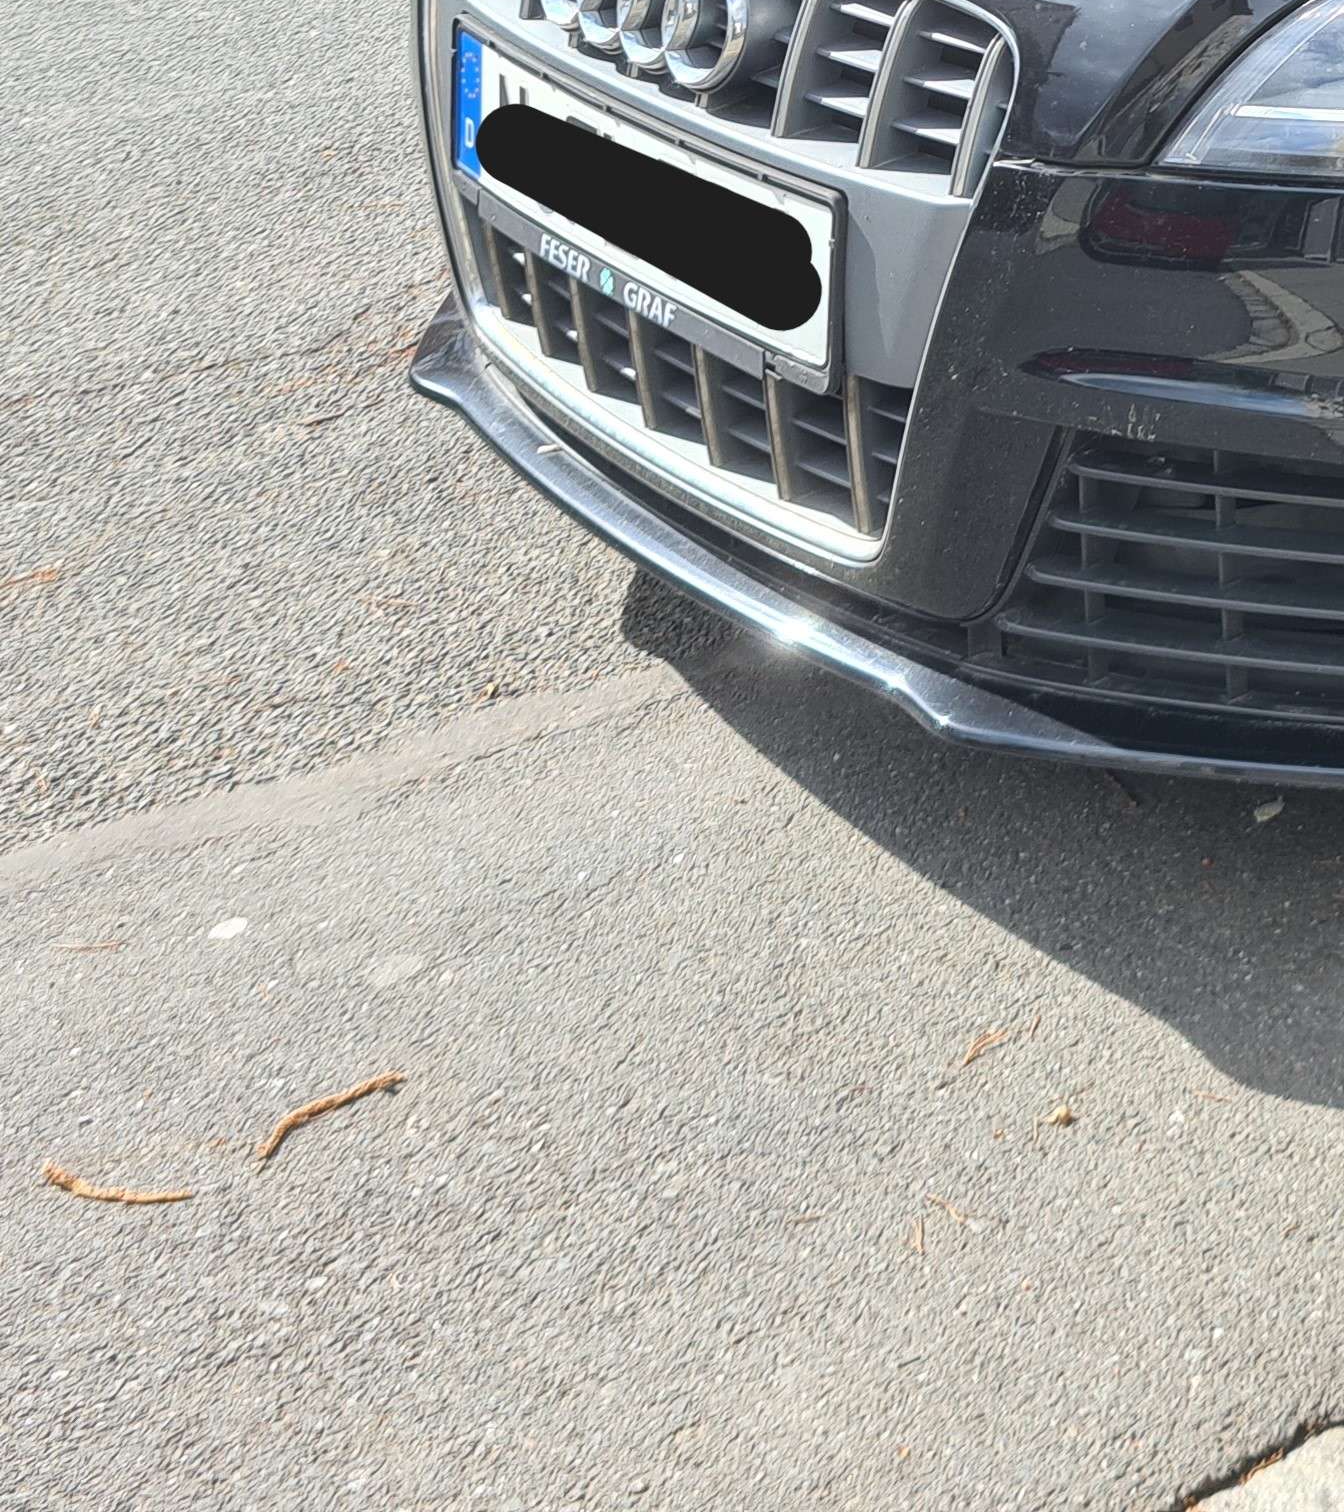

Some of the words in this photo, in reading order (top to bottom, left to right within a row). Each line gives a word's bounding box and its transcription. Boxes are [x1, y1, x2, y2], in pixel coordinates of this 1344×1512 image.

[464, 117, 475, 149] D
[539, 233, 591, 283] FESER
[623, 281, 678, 328] GRAF
